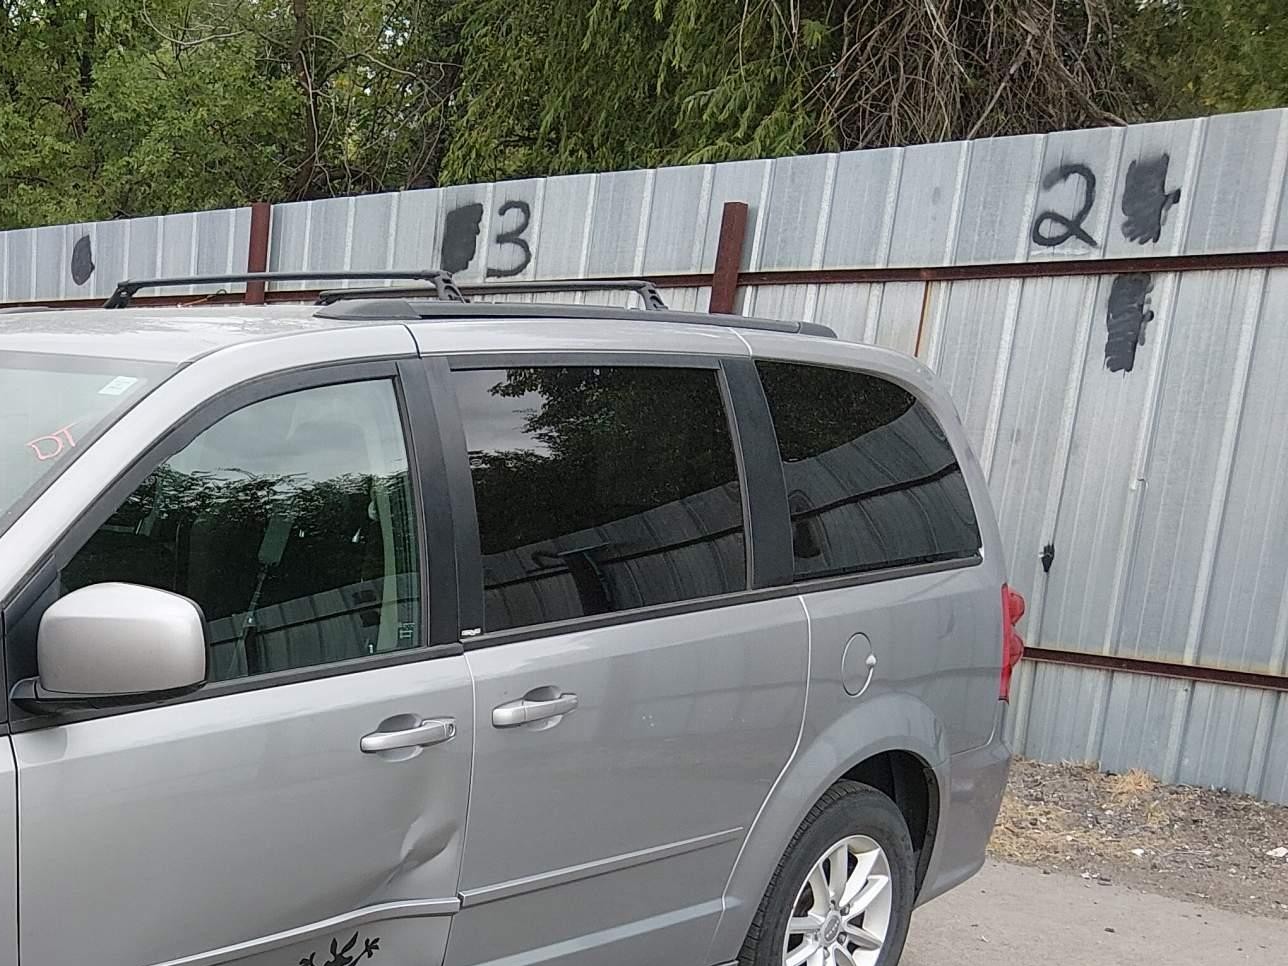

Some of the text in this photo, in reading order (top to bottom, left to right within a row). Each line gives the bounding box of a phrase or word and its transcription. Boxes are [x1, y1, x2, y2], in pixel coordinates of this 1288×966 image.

[486, 200, 532, 278] 3
[1032, 163, 1098, 247] 2
[25, 421, 78, 460] DT
